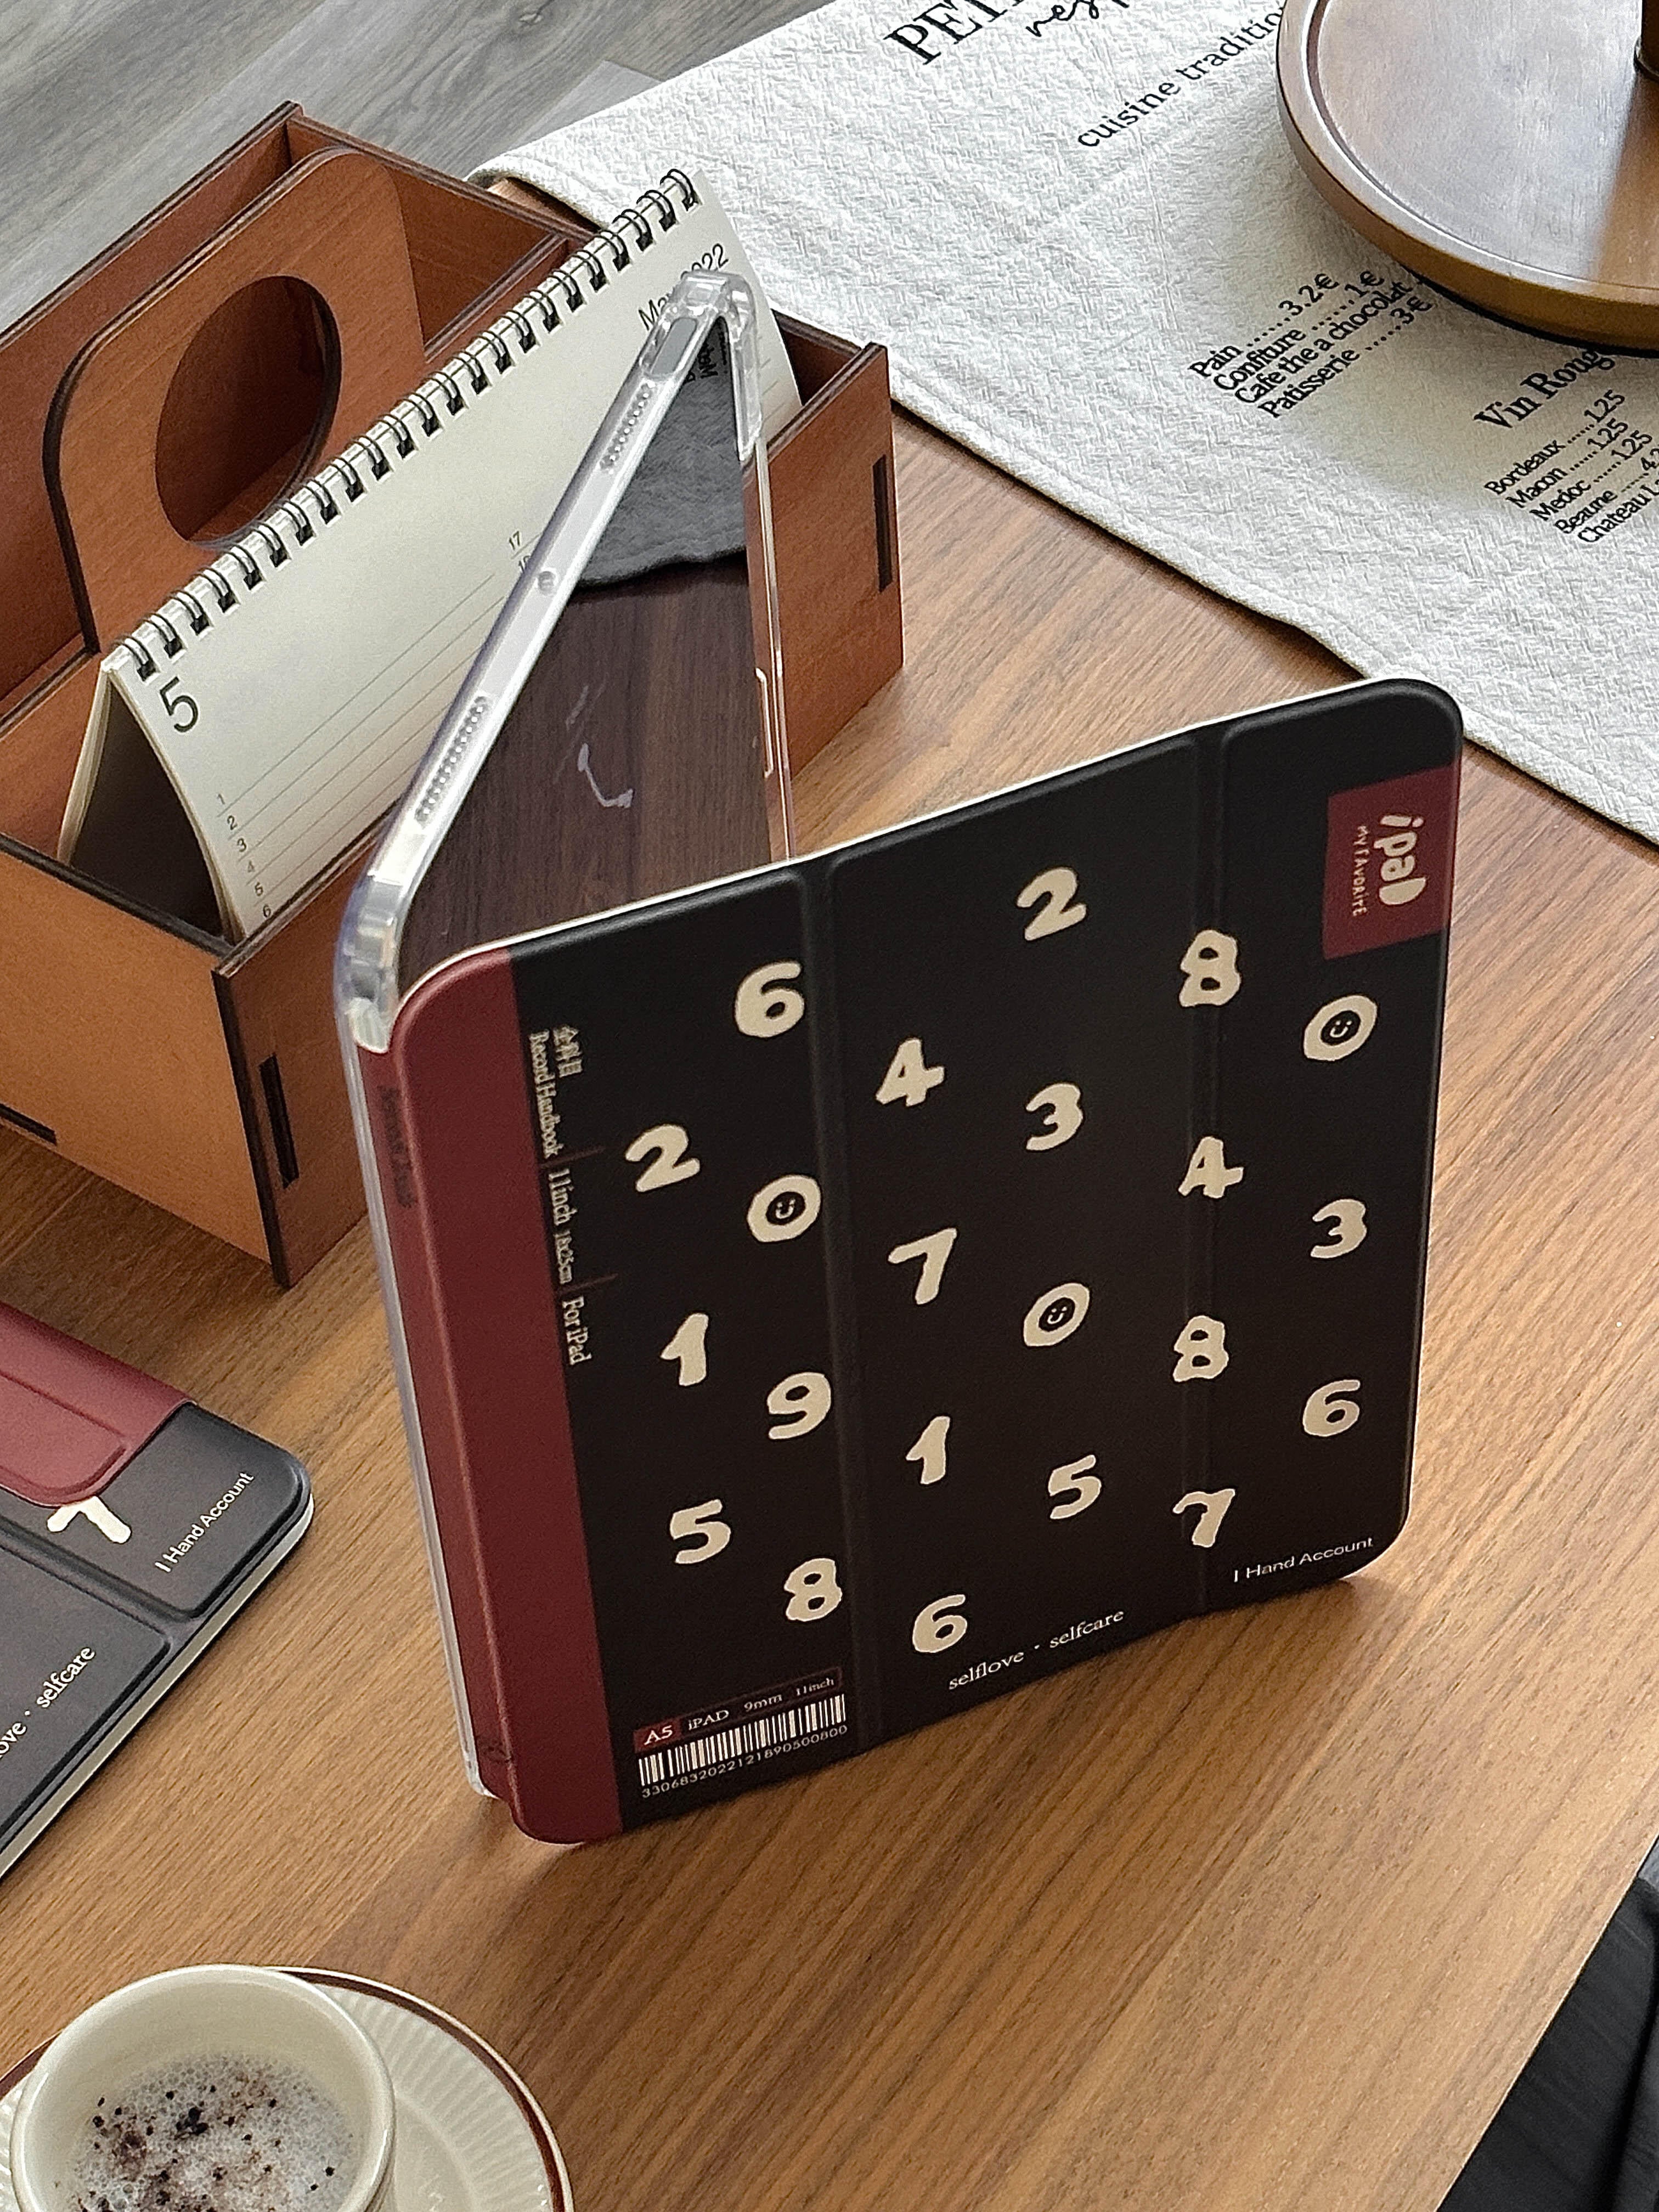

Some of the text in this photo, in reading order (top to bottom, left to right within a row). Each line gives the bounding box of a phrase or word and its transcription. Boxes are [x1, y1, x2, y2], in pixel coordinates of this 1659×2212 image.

[1078, 82, 1181, 146] cuisine
[1188, 345, 1244, 377] Pain
[1214, 329, 1306, 390] Confiture
[1235, 281, 1413, 403] Cafe the a chocolat
[1257, 349, 1361, 419] Patisserie
[1473, 397, 1543, 429] Vin
[1483, 439, 1566, 495] Bordeaux
[1505, 467, 1568, 509] Macon
[1529, 479, 1592, 521] Medoc
[1554, 490, 1618, 534] Beaune
[1577, 492, 1652, 543] Chateau
[509, 531, 521, 550] 17
[159, 676, 199, 733] 5
[217, 793, 225, 805] 1
[227, 815, 238, 831] 2
[236, 837, 247, 853] 3
[247, 860, 255, 873] 4
[1352, 825, 1370, 847] MY
[254, 882, 264, 897] 5
[262, 904, 272, 918] 6
[1017, 868, 1087, 941] 2
[735, 961, 805, 1038] 6
[1180, 930, 1242, 1007] 8
[1304, 995, 1378, 1062] 0
[528, 1029, 564, 1159] Record Handbook
[876, 1037, 945, 1107] 4
[1025, 1083, 1084, 1151] 3
[625, 1124, 700, 1192] 2
[1178, 1136, 1244, 1199] 4
[747, 1175, 821, 1243] 0
[1310, 1198, 1367, 1259] 3
[888, 1227, 957, 1305] 7
[561, 1296, 592, 1366] For iPad
[1023, 1283, 1090, 1347] 0
[660, 1313, 709, 1386] 1
[1173, 1315, 1229, 1383] 8
[767, 1372, 832, 1440] 9
[1302, 1379, 1361, 1437] 6
[905, 1415, 951, 1485] 1
[162, 1523, 205, 1564] Hand
[200, 1472, 254, 1528] Account
[1047, 1454, 1102, 1520] 5
[1172, 1487, 1236, 1548] 7
[47, 1495, 132, 1544] 7
[669, 1498, 731, 1564] 5
[1246, 1556, 1295, 1579] Hand
[1299, 1537, 1373, 1565] Account
[783, 1558, 843, 1622] 8
[912, 1594, 968, 1654] 6
[949, 1611, 1125, 1690] selflove selfcare
[36, 1647, 95, 1708] selfcare
[643, 1724, 673, 1746] A5
[687, 1709, 730, 1731] iPAD
[743, 1693, 783, 1713] 9mm
